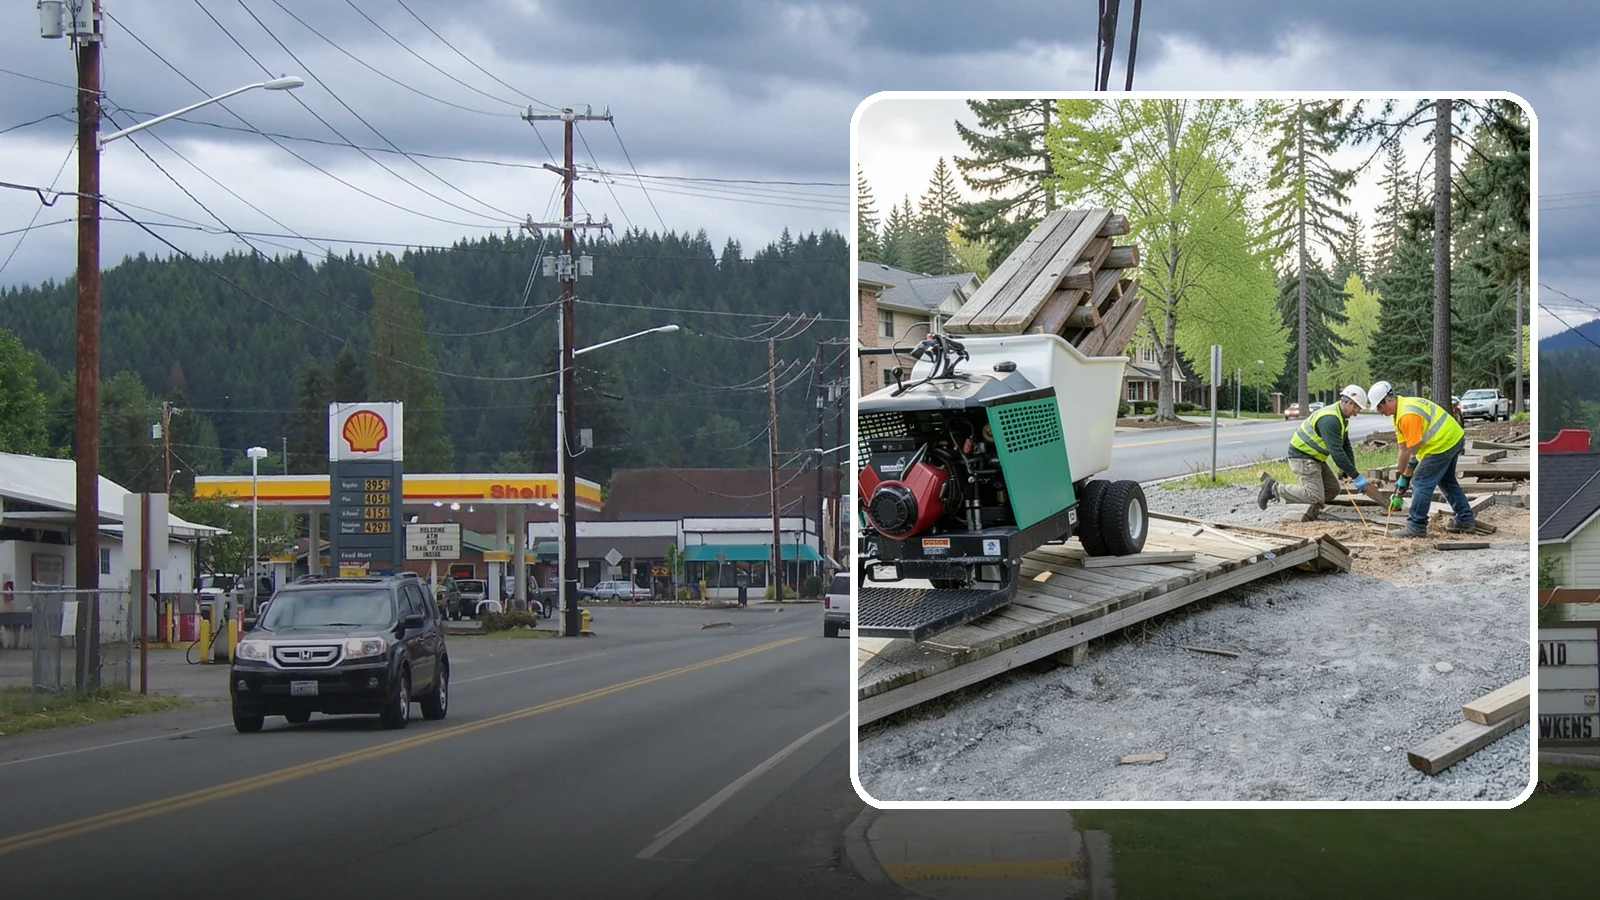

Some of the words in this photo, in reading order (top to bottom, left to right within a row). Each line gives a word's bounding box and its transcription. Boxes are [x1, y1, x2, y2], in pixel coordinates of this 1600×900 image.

[366, 480, 384, 490] 395
[490, 484, 547, 499] Shell
[366, 494, 384, 504] 405
[366, 508, 383, 518] 415
[366, 522, 384, 532] 429
